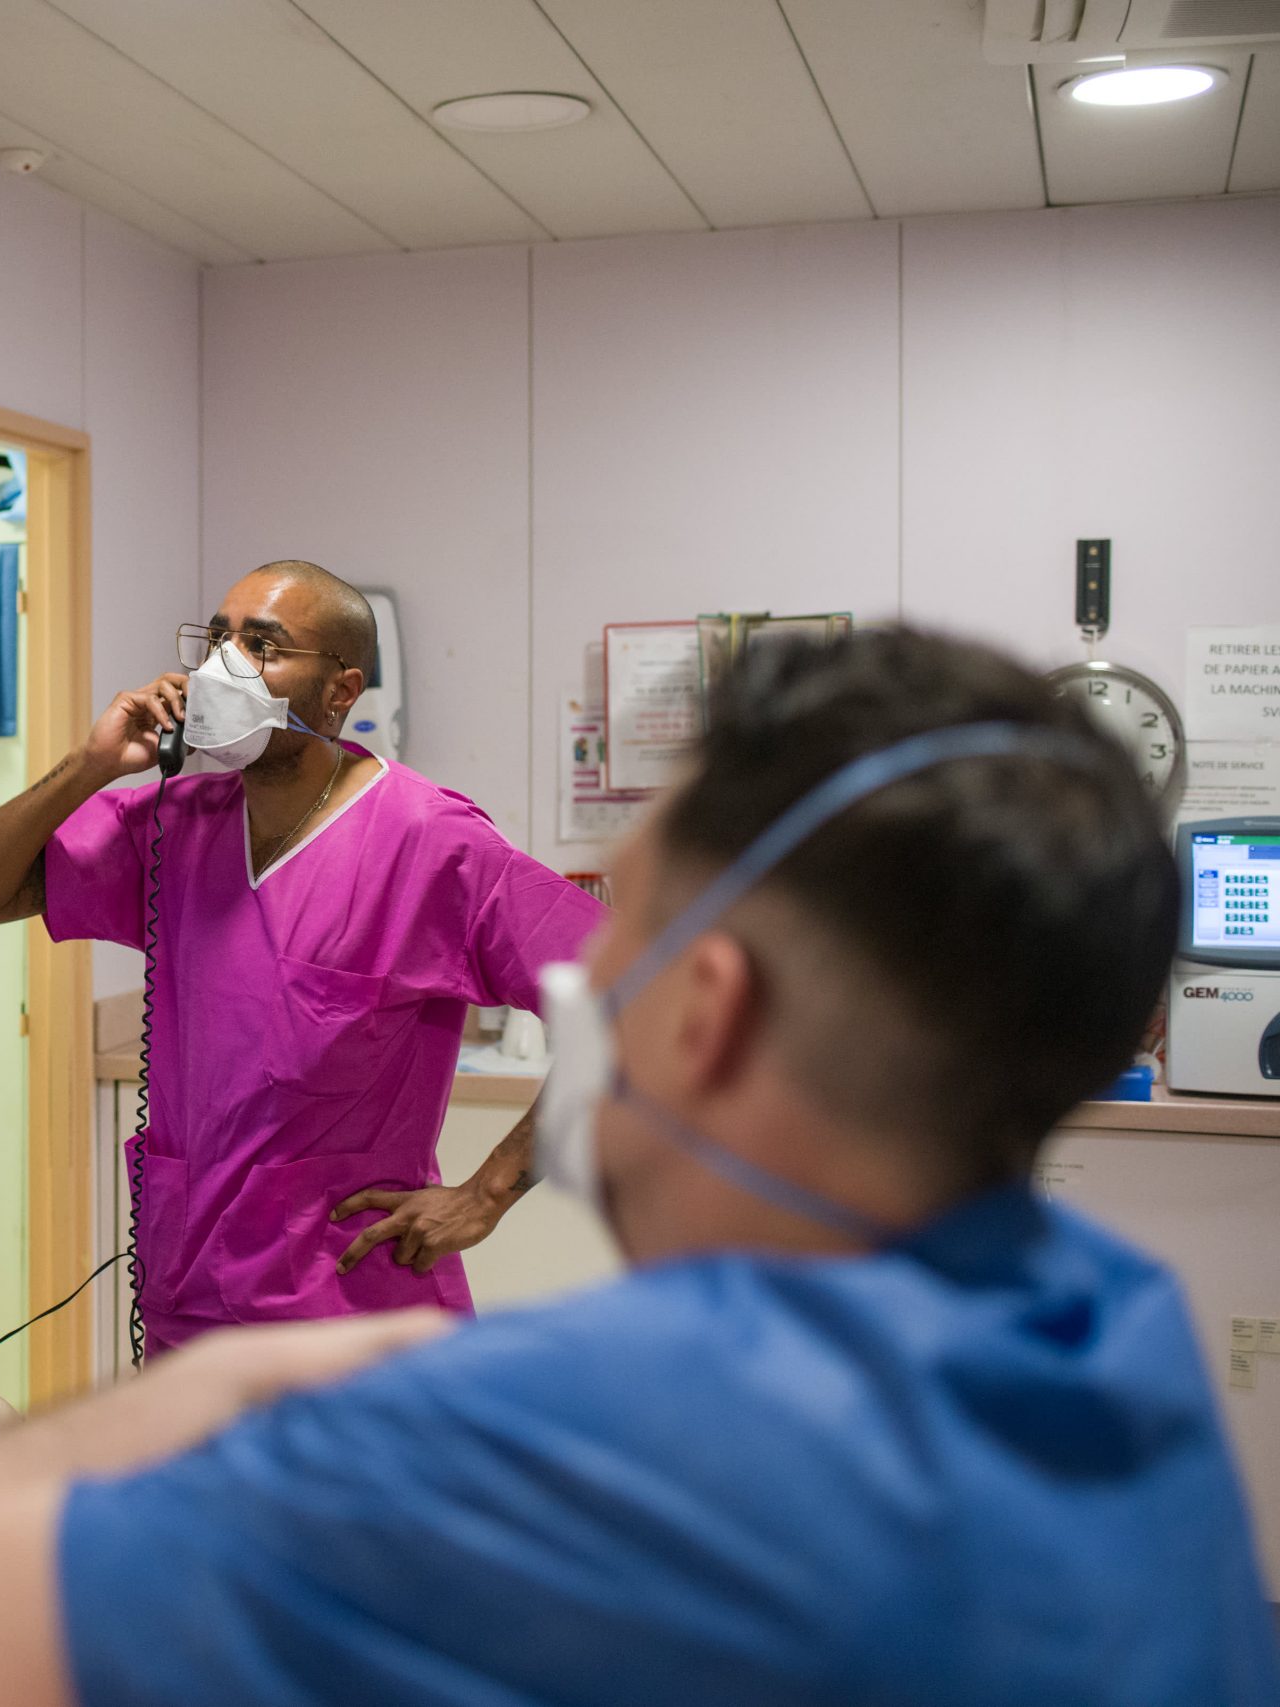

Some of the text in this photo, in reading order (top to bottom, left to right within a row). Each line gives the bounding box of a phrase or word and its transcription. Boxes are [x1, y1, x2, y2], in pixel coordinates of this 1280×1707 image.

[1210, 644, 1261, 655] RETIRER
[1204, 664, 1220, 675] DE
[1224, 664, 1269, 676] PAPIER
[1088, 680, 1108, 696] 12
[1211, 684, 1226, 695] LA
[1125, 689, 1131, 704] 1
[1262, 706, 1280, 718] SV
[1141, 712, 1158, 728] 2
[1150, 743, 1167, 759] 3
[1192, 760, 1264, 770] NOTE DE SERVICE
[1183, 986, 1219, 999] GEM
[1220, 991, 1254, 1002] 4000
